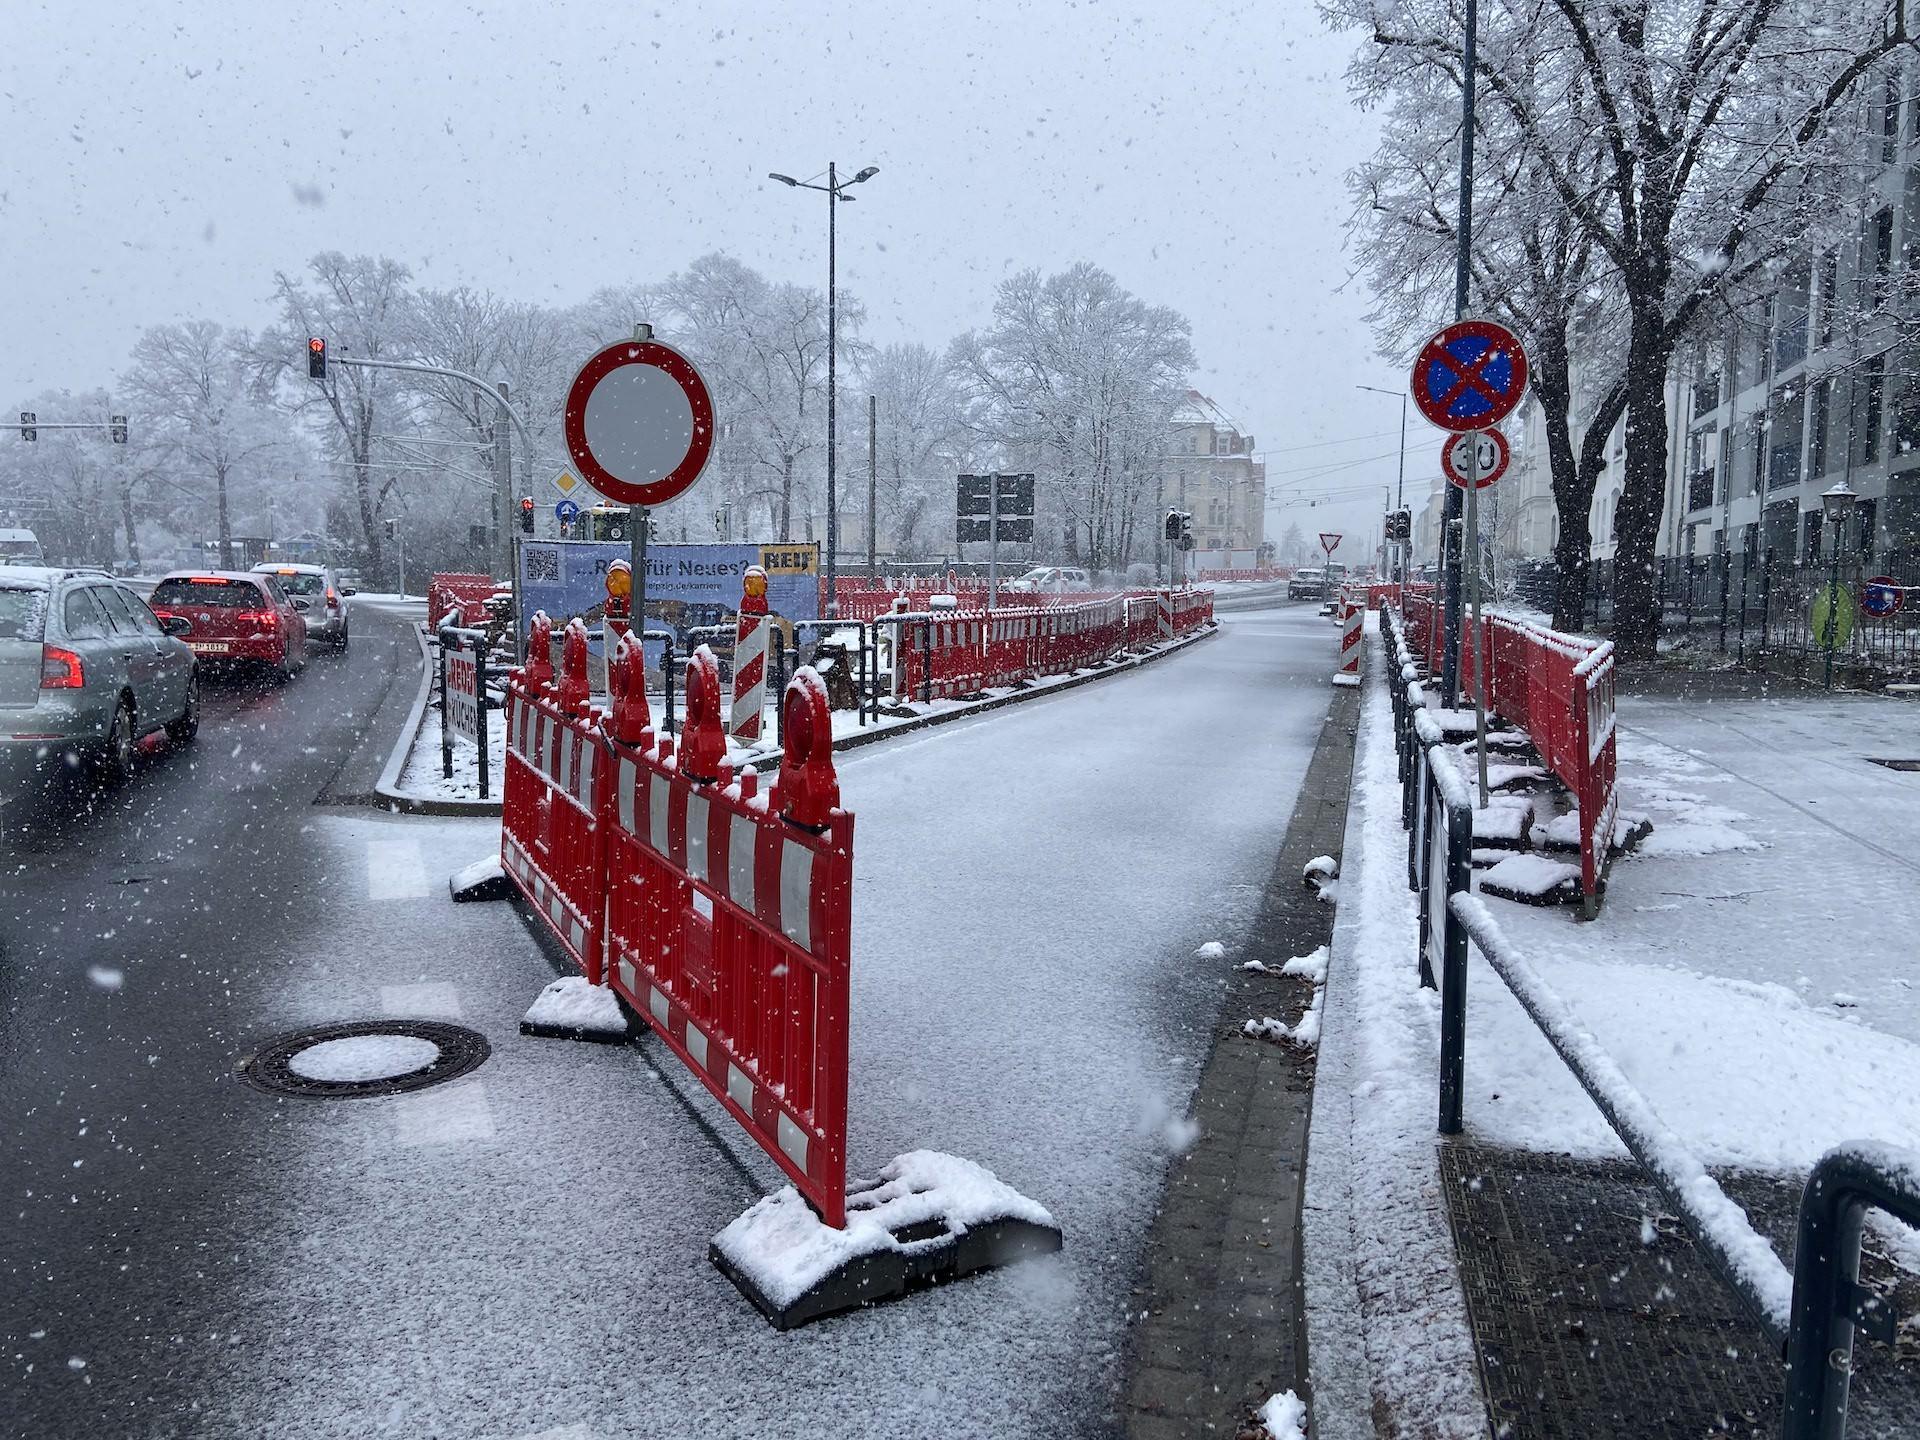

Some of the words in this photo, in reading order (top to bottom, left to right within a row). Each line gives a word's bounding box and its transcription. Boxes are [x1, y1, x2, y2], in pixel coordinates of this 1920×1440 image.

[1456, 442, 1495, 471] 30
[645, 559, 673, 576] für
[679, 560, 750, 577] Neues?
[764, 551, 813, 571] REIF
